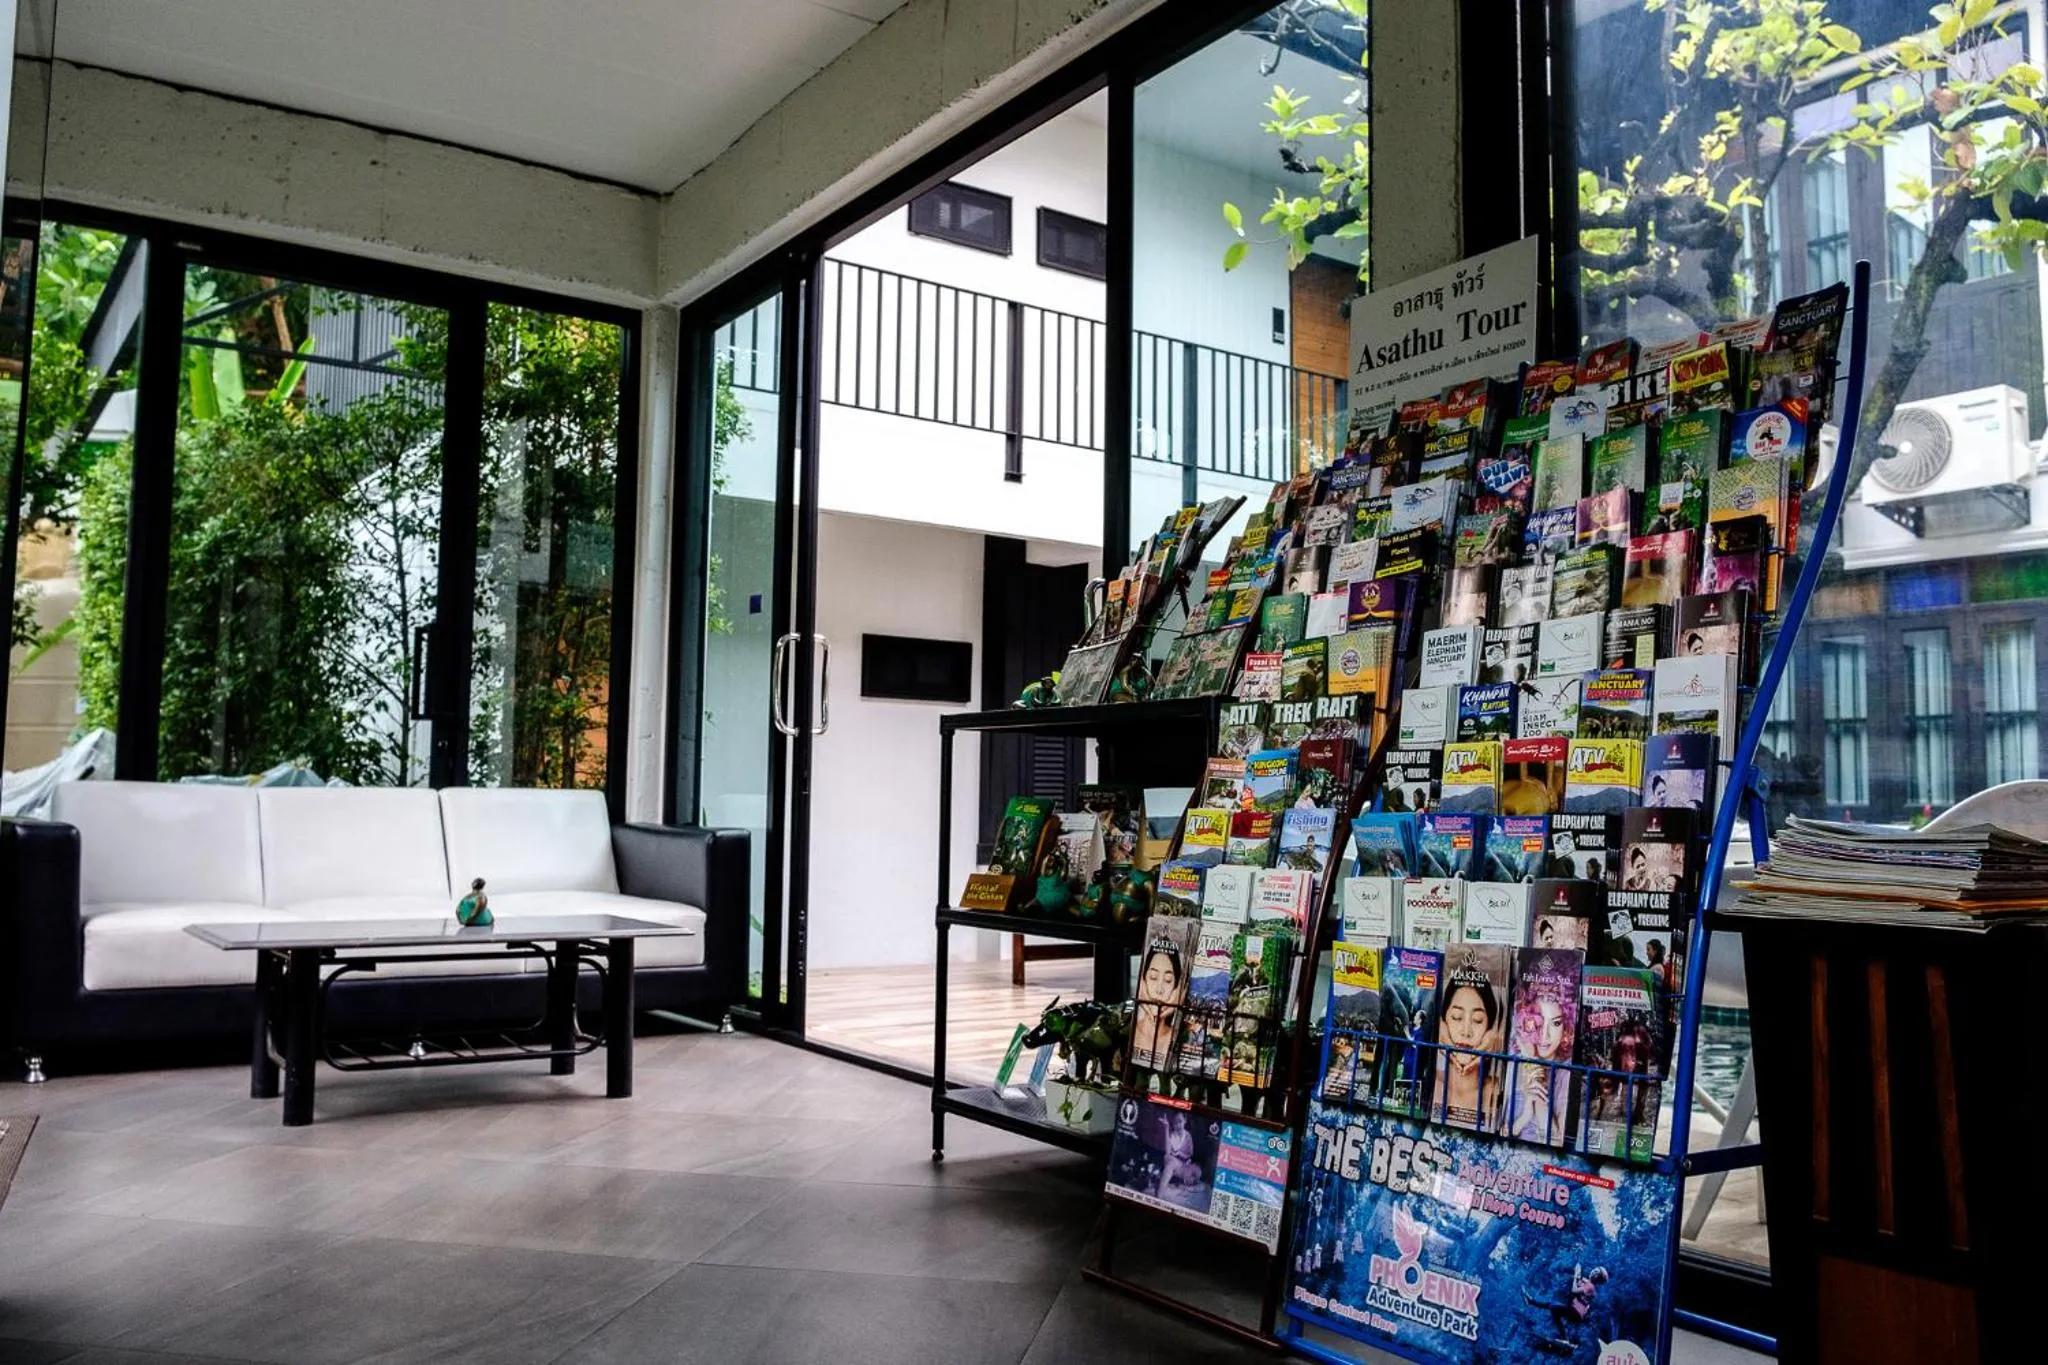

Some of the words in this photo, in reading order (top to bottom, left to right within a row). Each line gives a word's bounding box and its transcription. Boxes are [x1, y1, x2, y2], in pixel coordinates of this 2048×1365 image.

[1778, 305, 1838, 329] SANCTUARY
[1356, 327, 1444, 375] Asathu
[1456, 301, 1527, 342] Tour
[1607, 368, 1667, 408] BIKE
[1427, 644, 1466, 658] ELEPHANT
[1428, 632, 1467, 649] MAERIM
[1426, 653, 1467, 666] SANCTUARY
[1586, 680, 1646, 690] SANCTUARY
[1316, 695, 1358, 718] RAFT
[1462, 687, 1511, 707] KHAMPAN
[1229, 704, 1259, 725] ATV
[1275, 702, 1313, 723] TREK
[1522, 714, 1547, 722] SIAM
[1523, 720, 1558, 730] INSECT
[1386, 751, 1416, 764] ELEPHANT
[1416, 751, 1431, 764] CARE
[1446, 750, 1477, 774] ATV
[1569, 747, 1606, 773] ATV
[1187, 815, 1212, 831] ATV
[1552, 815, 1590, 829] ELEPHANT
[1590, 815, 1606, 829] CARE
[1608, 891, 1649, 908] ELEPHANT
[1650, 892, 1670, 909] CARE
[1334, 951, 1359, 973] ATV
[1449, 967, 1491, 983] MAKKHA
[1587, 987, 1624, 998] PARADISE
[1624, 990, 1642, 1000] PARK
[1313, 1122, 1366, 1182] THE
[1369, 1134, 1454, 1200] BEST
[1457, 1157, 1570, 1207] Adventure
[1483, 1191, 1515, 1217] Rope
[1518, 1202, 1566, 1230] Course
[1368, 1253, 1481, 1317] PHOENIX
[1294, 1285, 1328, 1310] Please
[1328, 1297, 1371, 1325] Contact
[1370, 1312, 1398, 1335] Here
[1367, 1285, 1440, 1327] Adventure
[1441, 1310, 1478, 1341] Park
